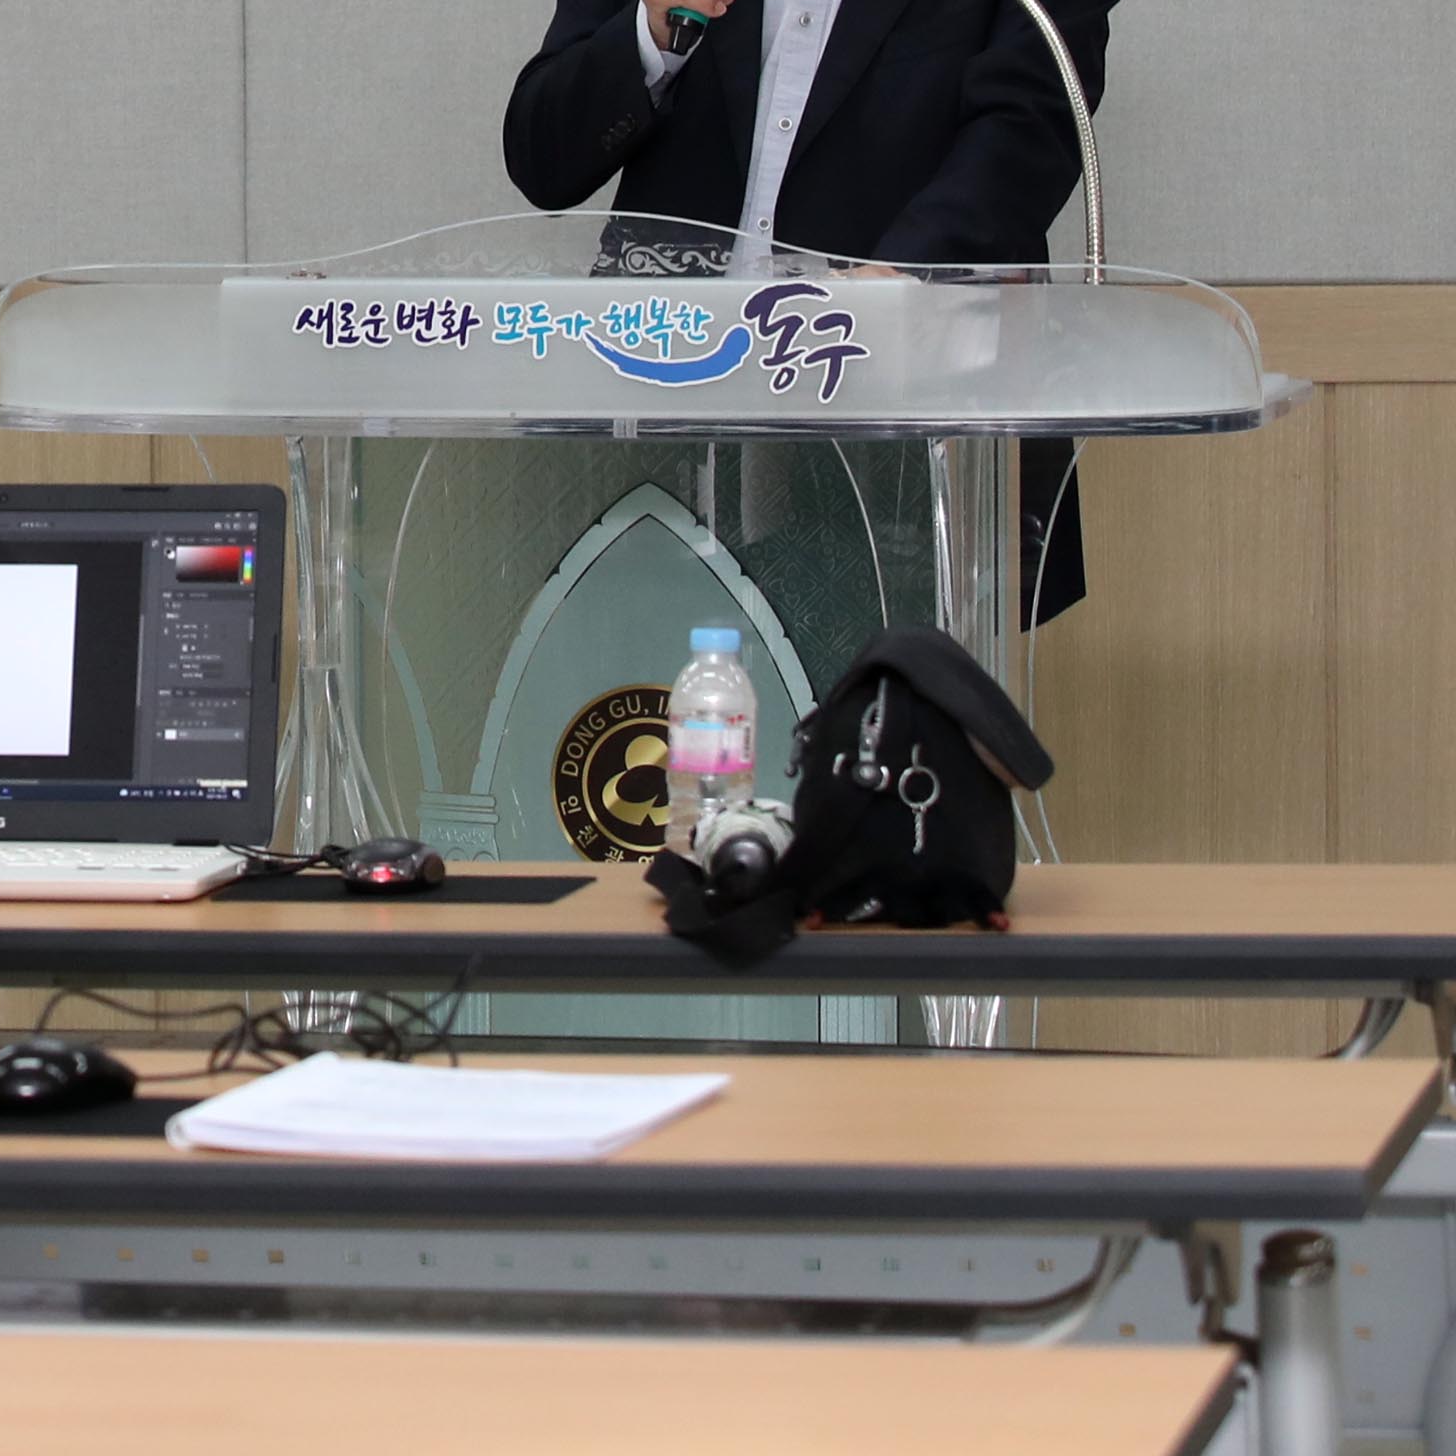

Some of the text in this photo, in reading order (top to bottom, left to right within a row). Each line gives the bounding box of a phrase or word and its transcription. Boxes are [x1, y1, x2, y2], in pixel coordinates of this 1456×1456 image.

[295, 282, 869, 402] 새로운 변화 모두가 행복한 동구
[561, 712, 606, 777] DONG
